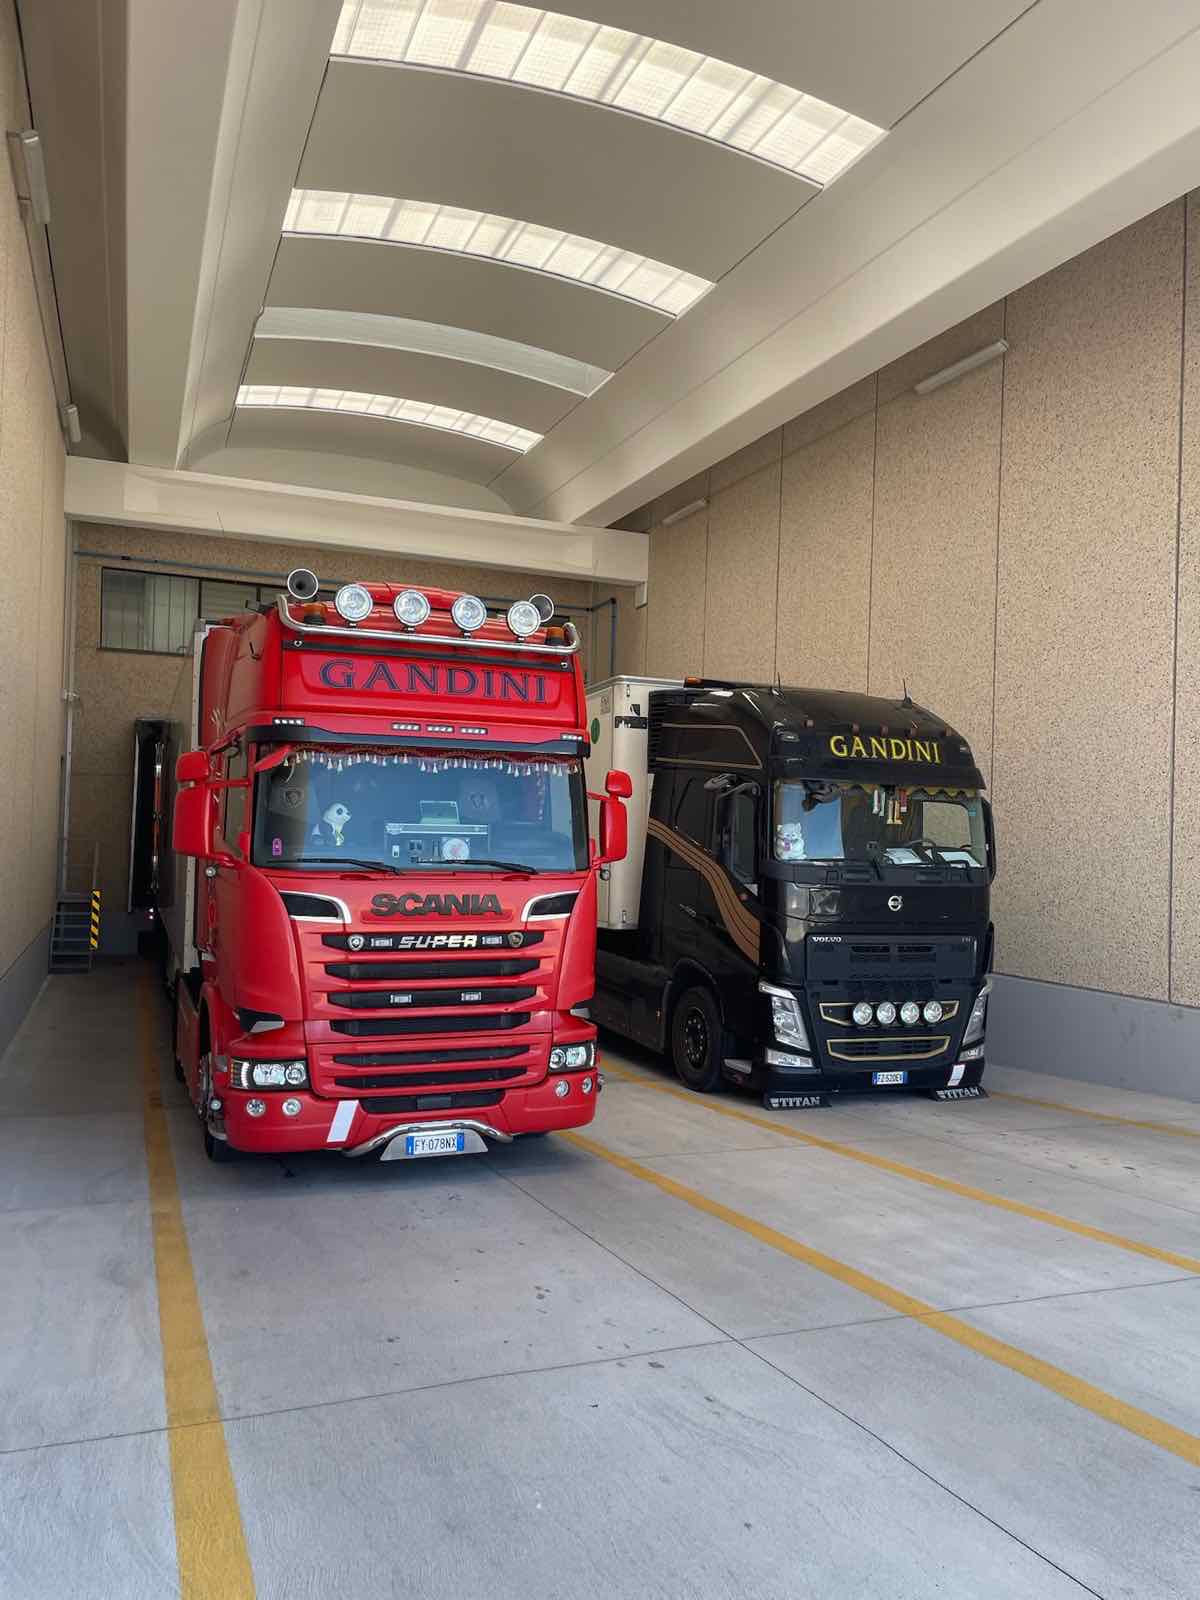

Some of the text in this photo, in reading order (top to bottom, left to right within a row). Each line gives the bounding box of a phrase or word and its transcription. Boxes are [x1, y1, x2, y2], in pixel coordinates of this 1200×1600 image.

[319, 659, 548, 704] GANDINI
[830, 735, 942, 763] GANDINI
[371, 893, 503, 916] SCANIA
[398, 935, 478, 949] SUPER
[779, 1096, 820, 1107] TITAN
[944, 1087, 980, 1099] TITAN
